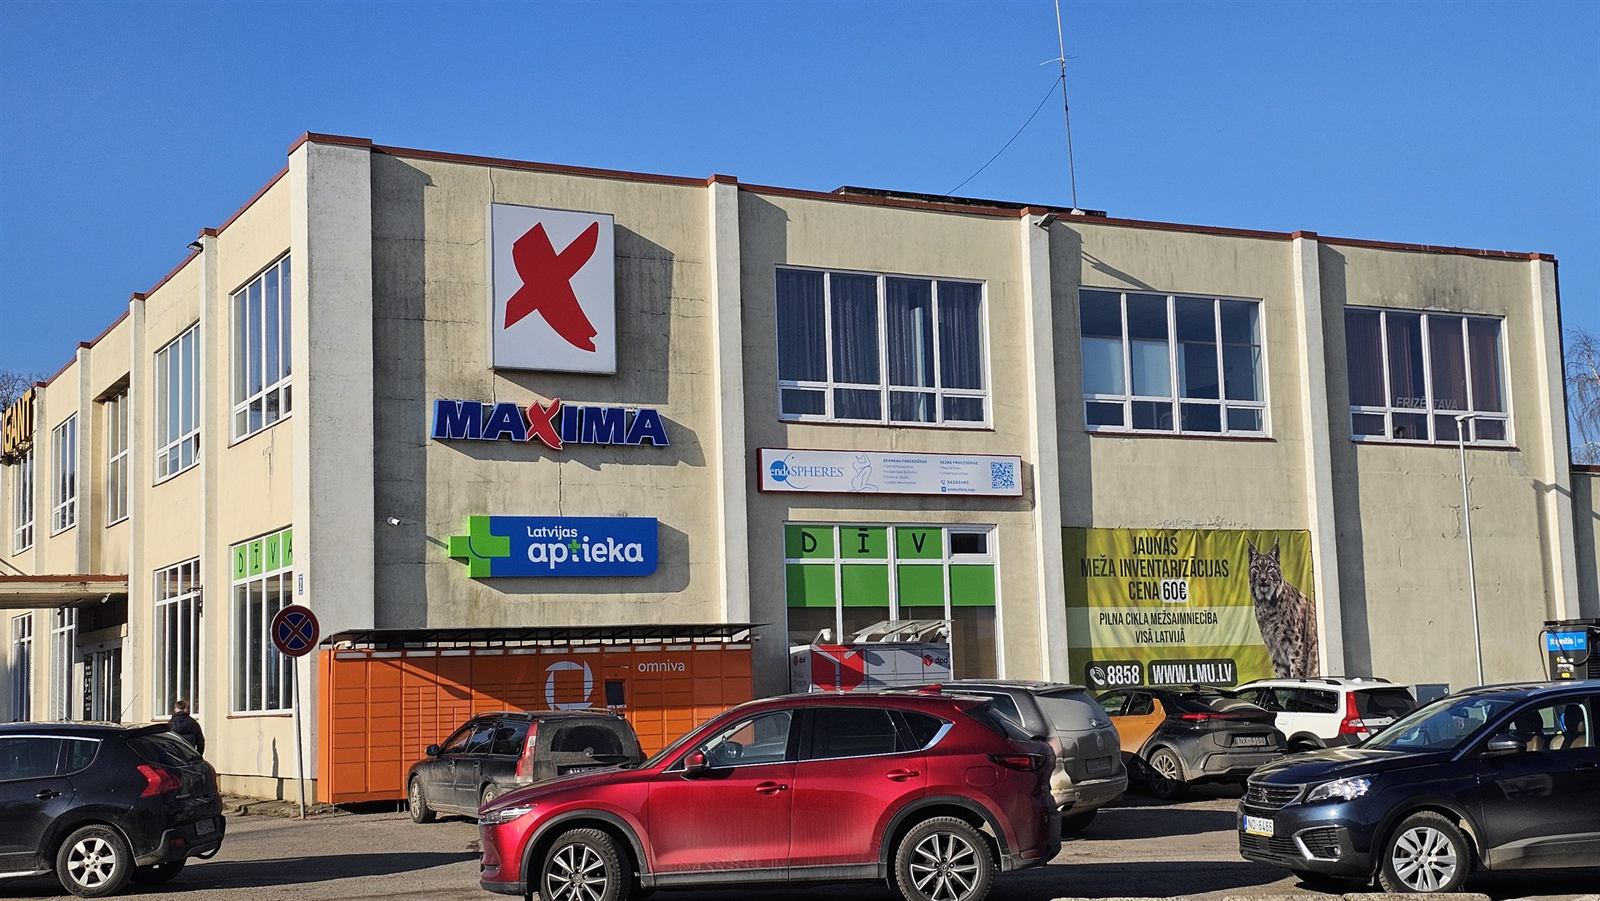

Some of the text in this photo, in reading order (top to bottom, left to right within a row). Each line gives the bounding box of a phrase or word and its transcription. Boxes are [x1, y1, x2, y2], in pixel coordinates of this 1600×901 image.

[432, 398, 670, 450] MAXIMA
[527, 536, 643, 569] aptieka
[1132, 536, 1178, 555] JAUNAS
[1081, 554, 1229, 578] MEŽA INVENTARIZĀCIJAS
[1128, 581, 1187, 600] CENA 60€
[1099, 610, 1218, 625] PILNA CIKLA MEŽSAIMNIECĪBA
[1135, 627, 1186, 643] VISĀ LATVIJĀ
[638, 659, 685, 672] omniva
[935, 657, 948, 665] dpd
[1107, 663, 1232, 685] 8858 WWW.LMU.LV
